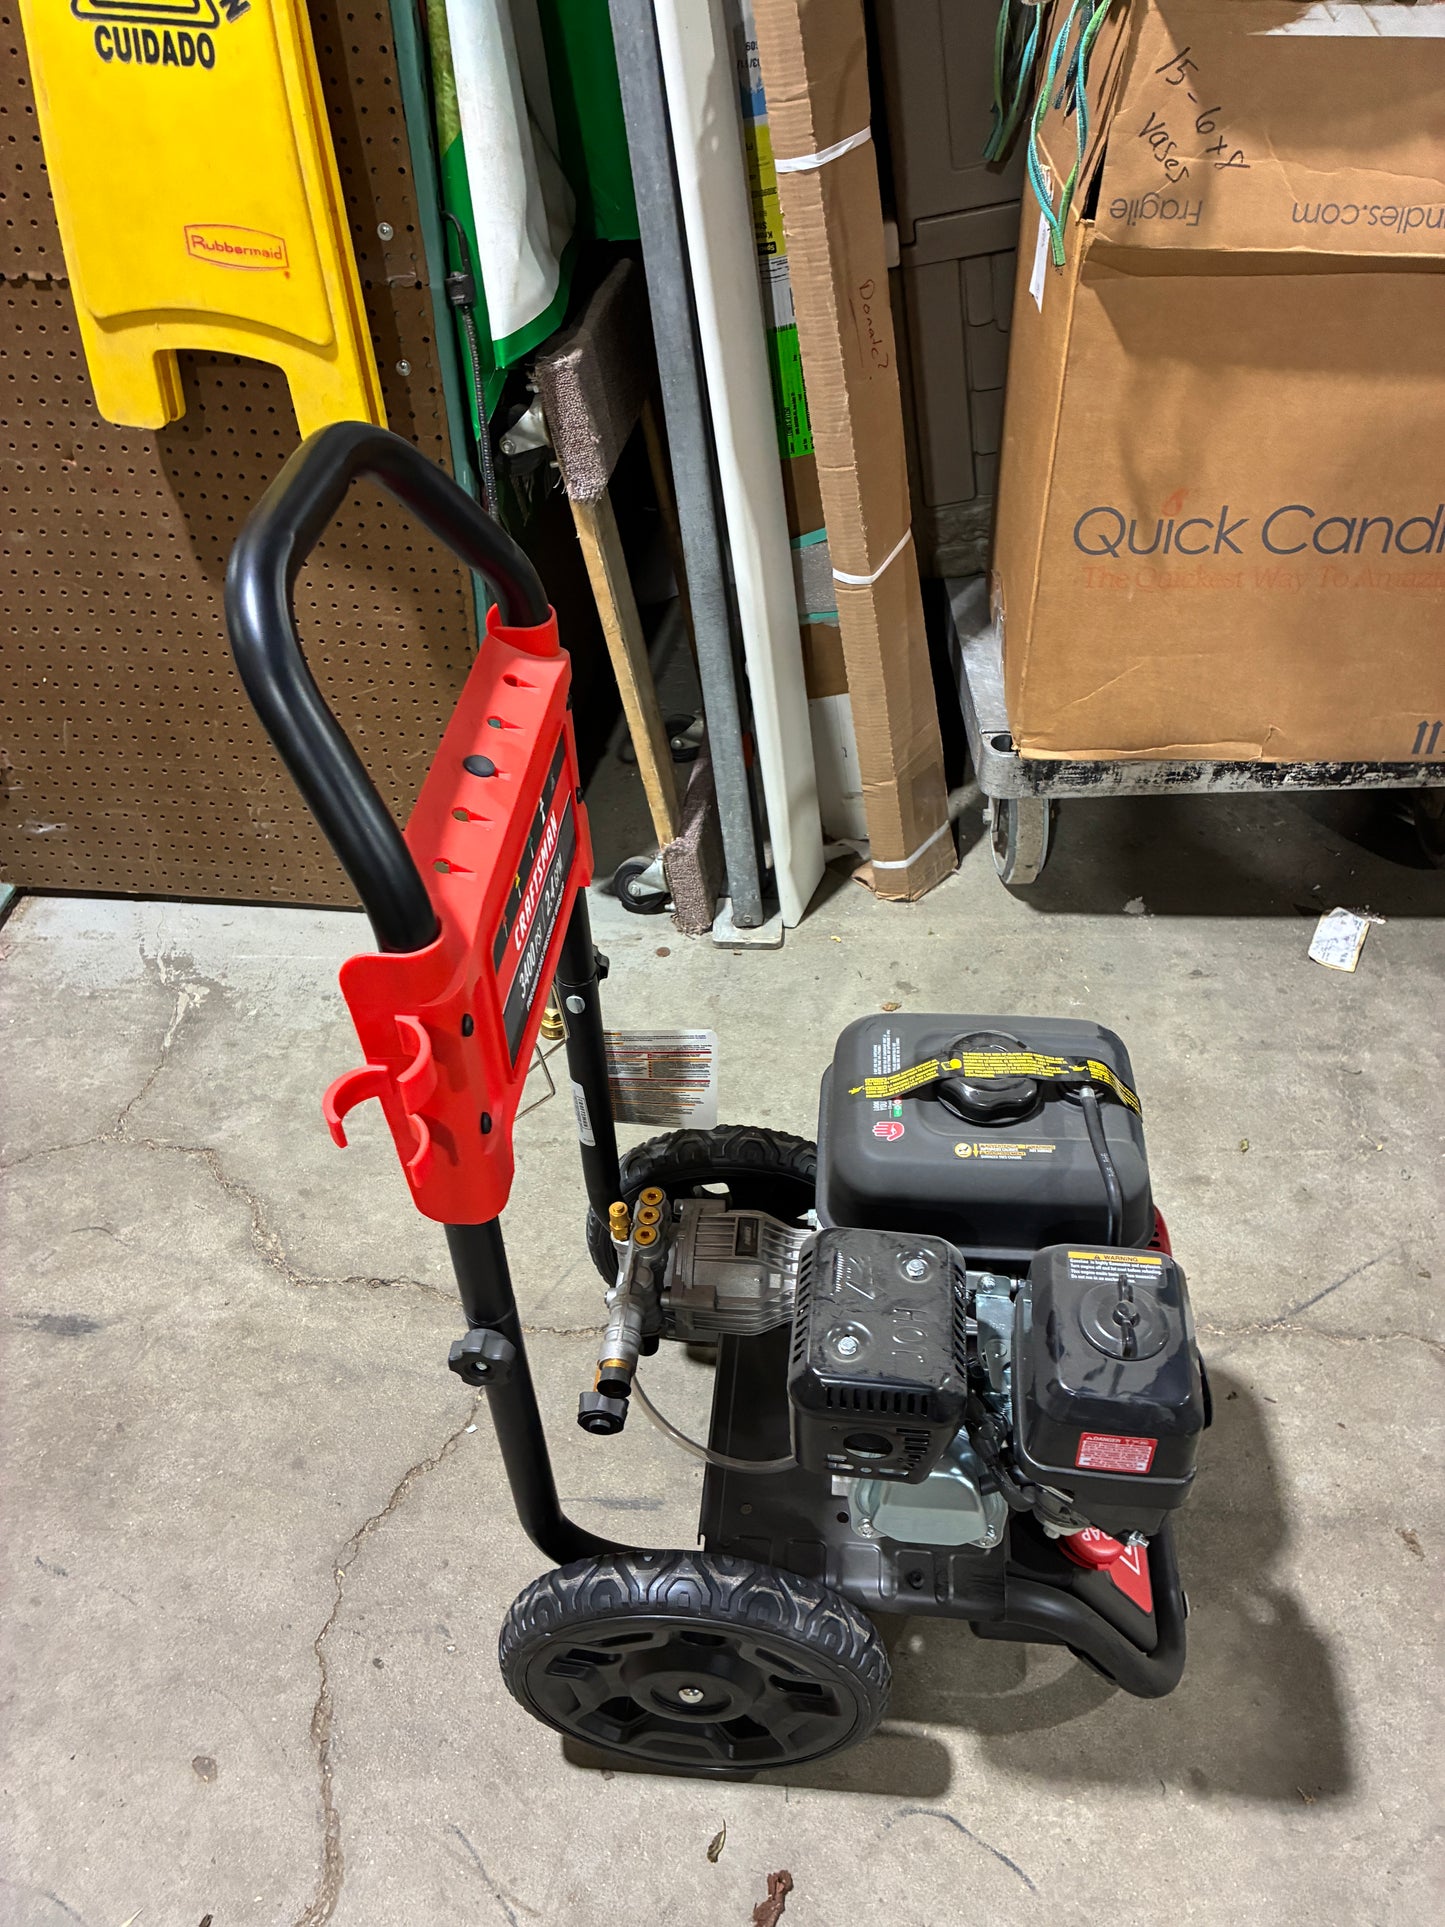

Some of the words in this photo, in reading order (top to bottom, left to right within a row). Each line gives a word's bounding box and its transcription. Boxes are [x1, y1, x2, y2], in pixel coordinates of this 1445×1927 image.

[94, 25, 216, 70] CUIDADO
[1110, 192, 1203, 227] Fragile
[1292, 203, 1445, 234] ndles.com
[191, 235, 283, 260] Rubbermaid
[1073, 505, 1250, 558] Quick
[1081, 565, 1129, 589] The
[1136, 565, 1246, 593] Quickest
[1249, 566, 1302, 593] Way
[514, 810, 558, 951] CRAFTSMAN
[519, 941, 536, 999] 3400
